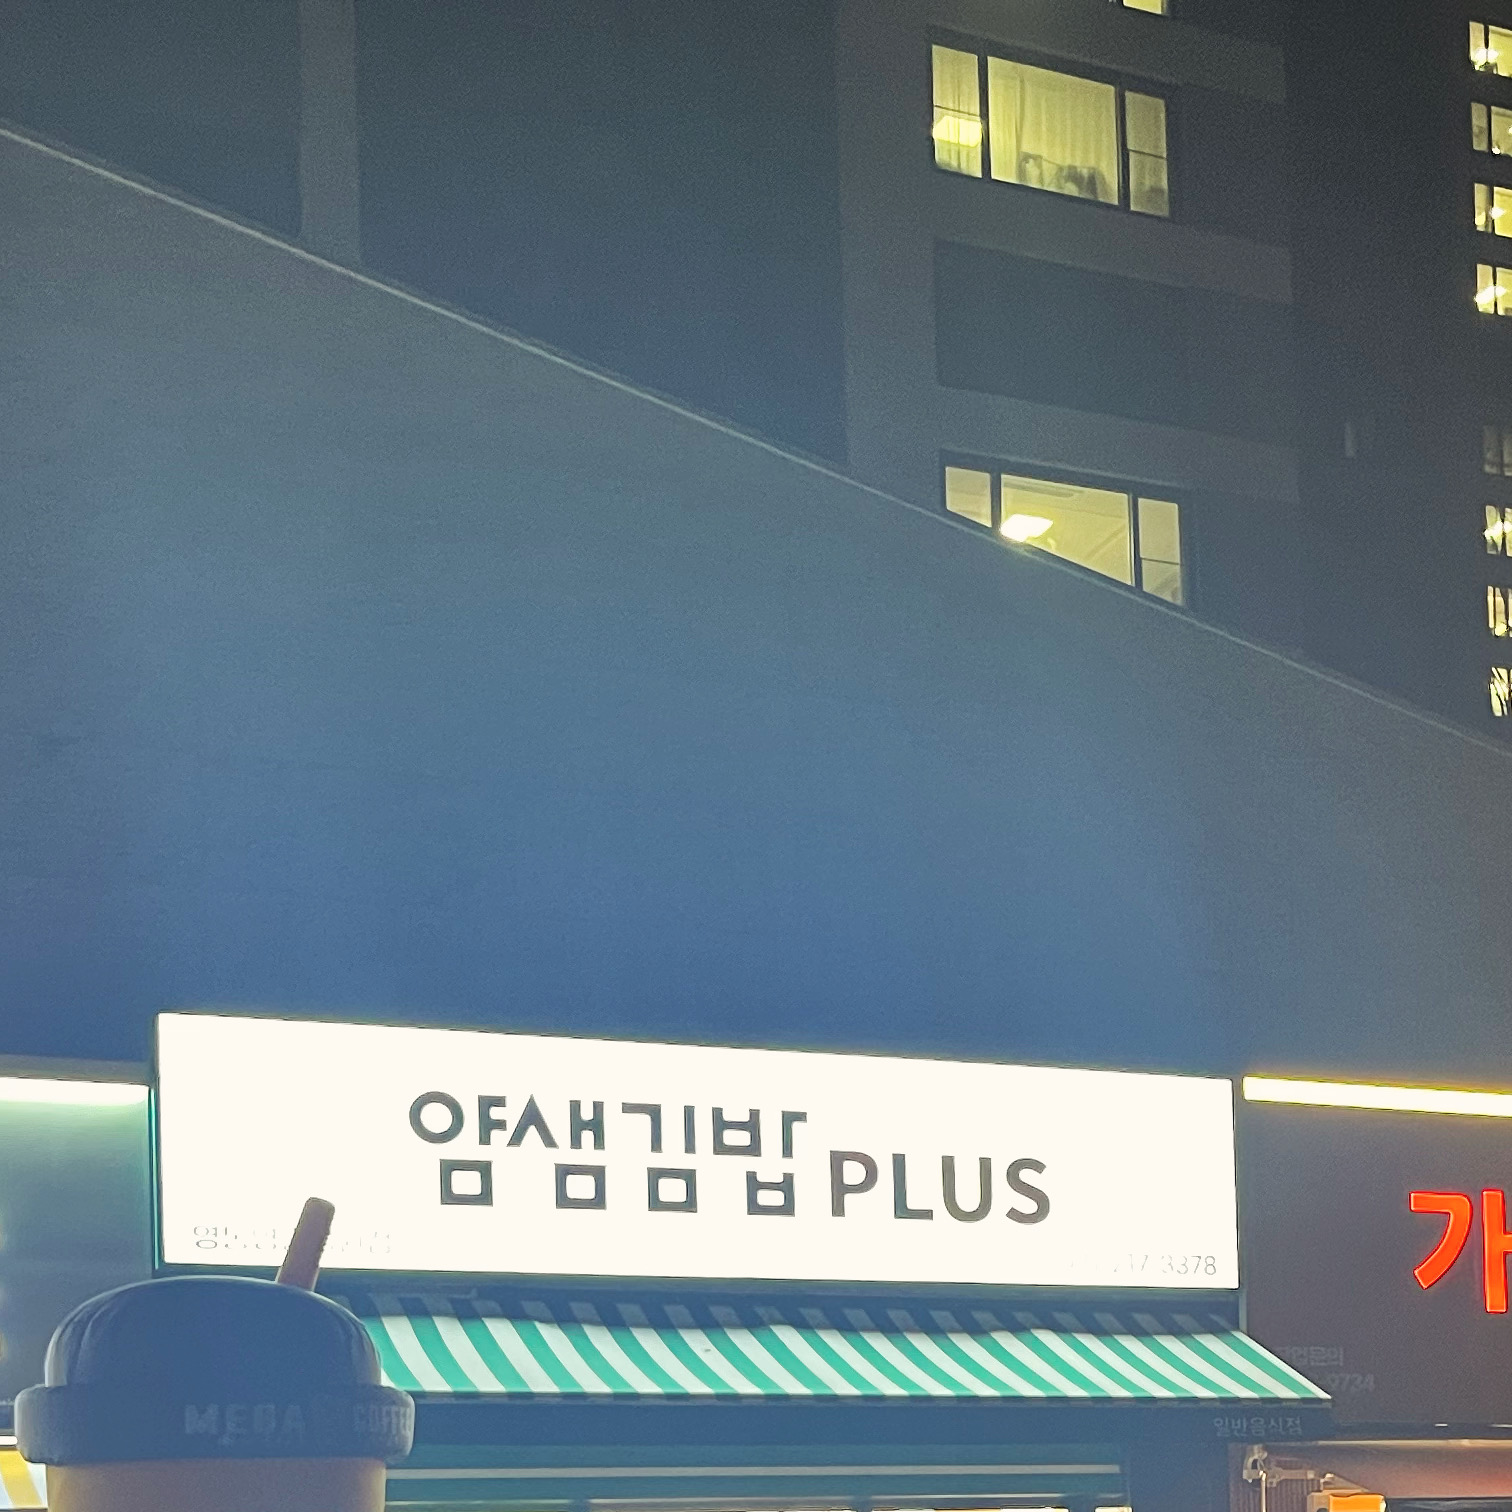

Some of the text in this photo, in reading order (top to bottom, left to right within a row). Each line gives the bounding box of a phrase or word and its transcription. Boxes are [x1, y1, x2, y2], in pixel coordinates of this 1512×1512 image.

[408, 1090, 1052, 1226] 얌샘김밥 PLUS
[1213, 1416, 1303, 1437] 일반음식점
